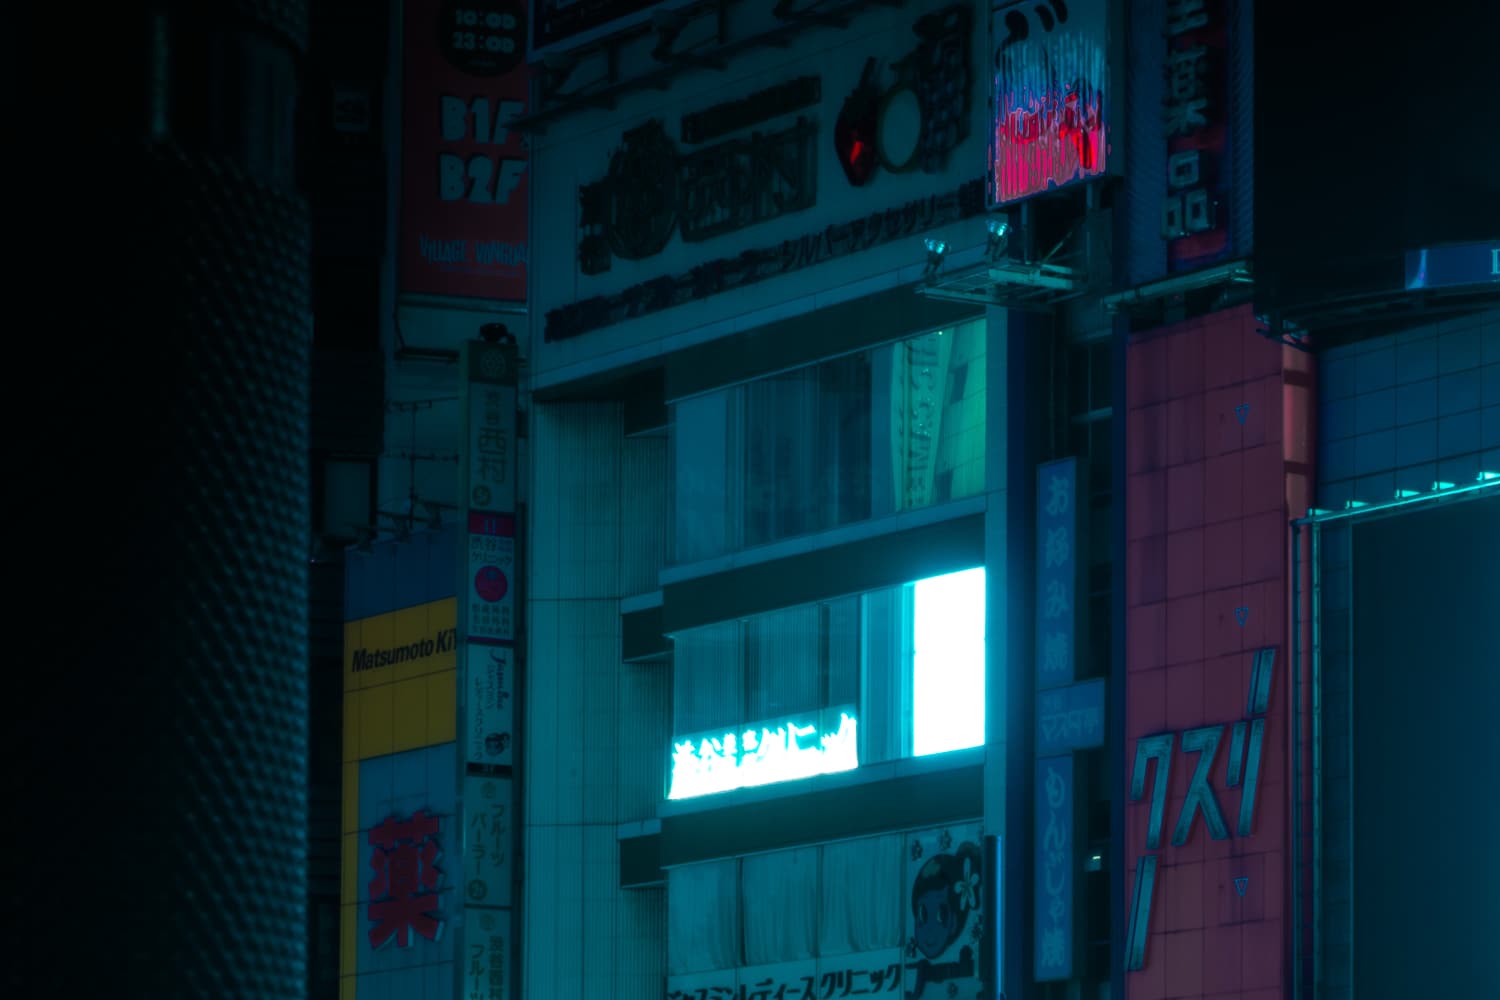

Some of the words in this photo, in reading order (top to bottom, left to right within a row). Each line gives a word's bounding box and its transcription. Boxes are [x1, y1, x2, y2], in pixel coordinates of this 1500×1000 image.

[439, 94, 526, 144] B1F
[437, 153, 528, 204] B2F
[351, 637, 435, 673] Matsumoto
[367, 810, 443, 949] 薬
